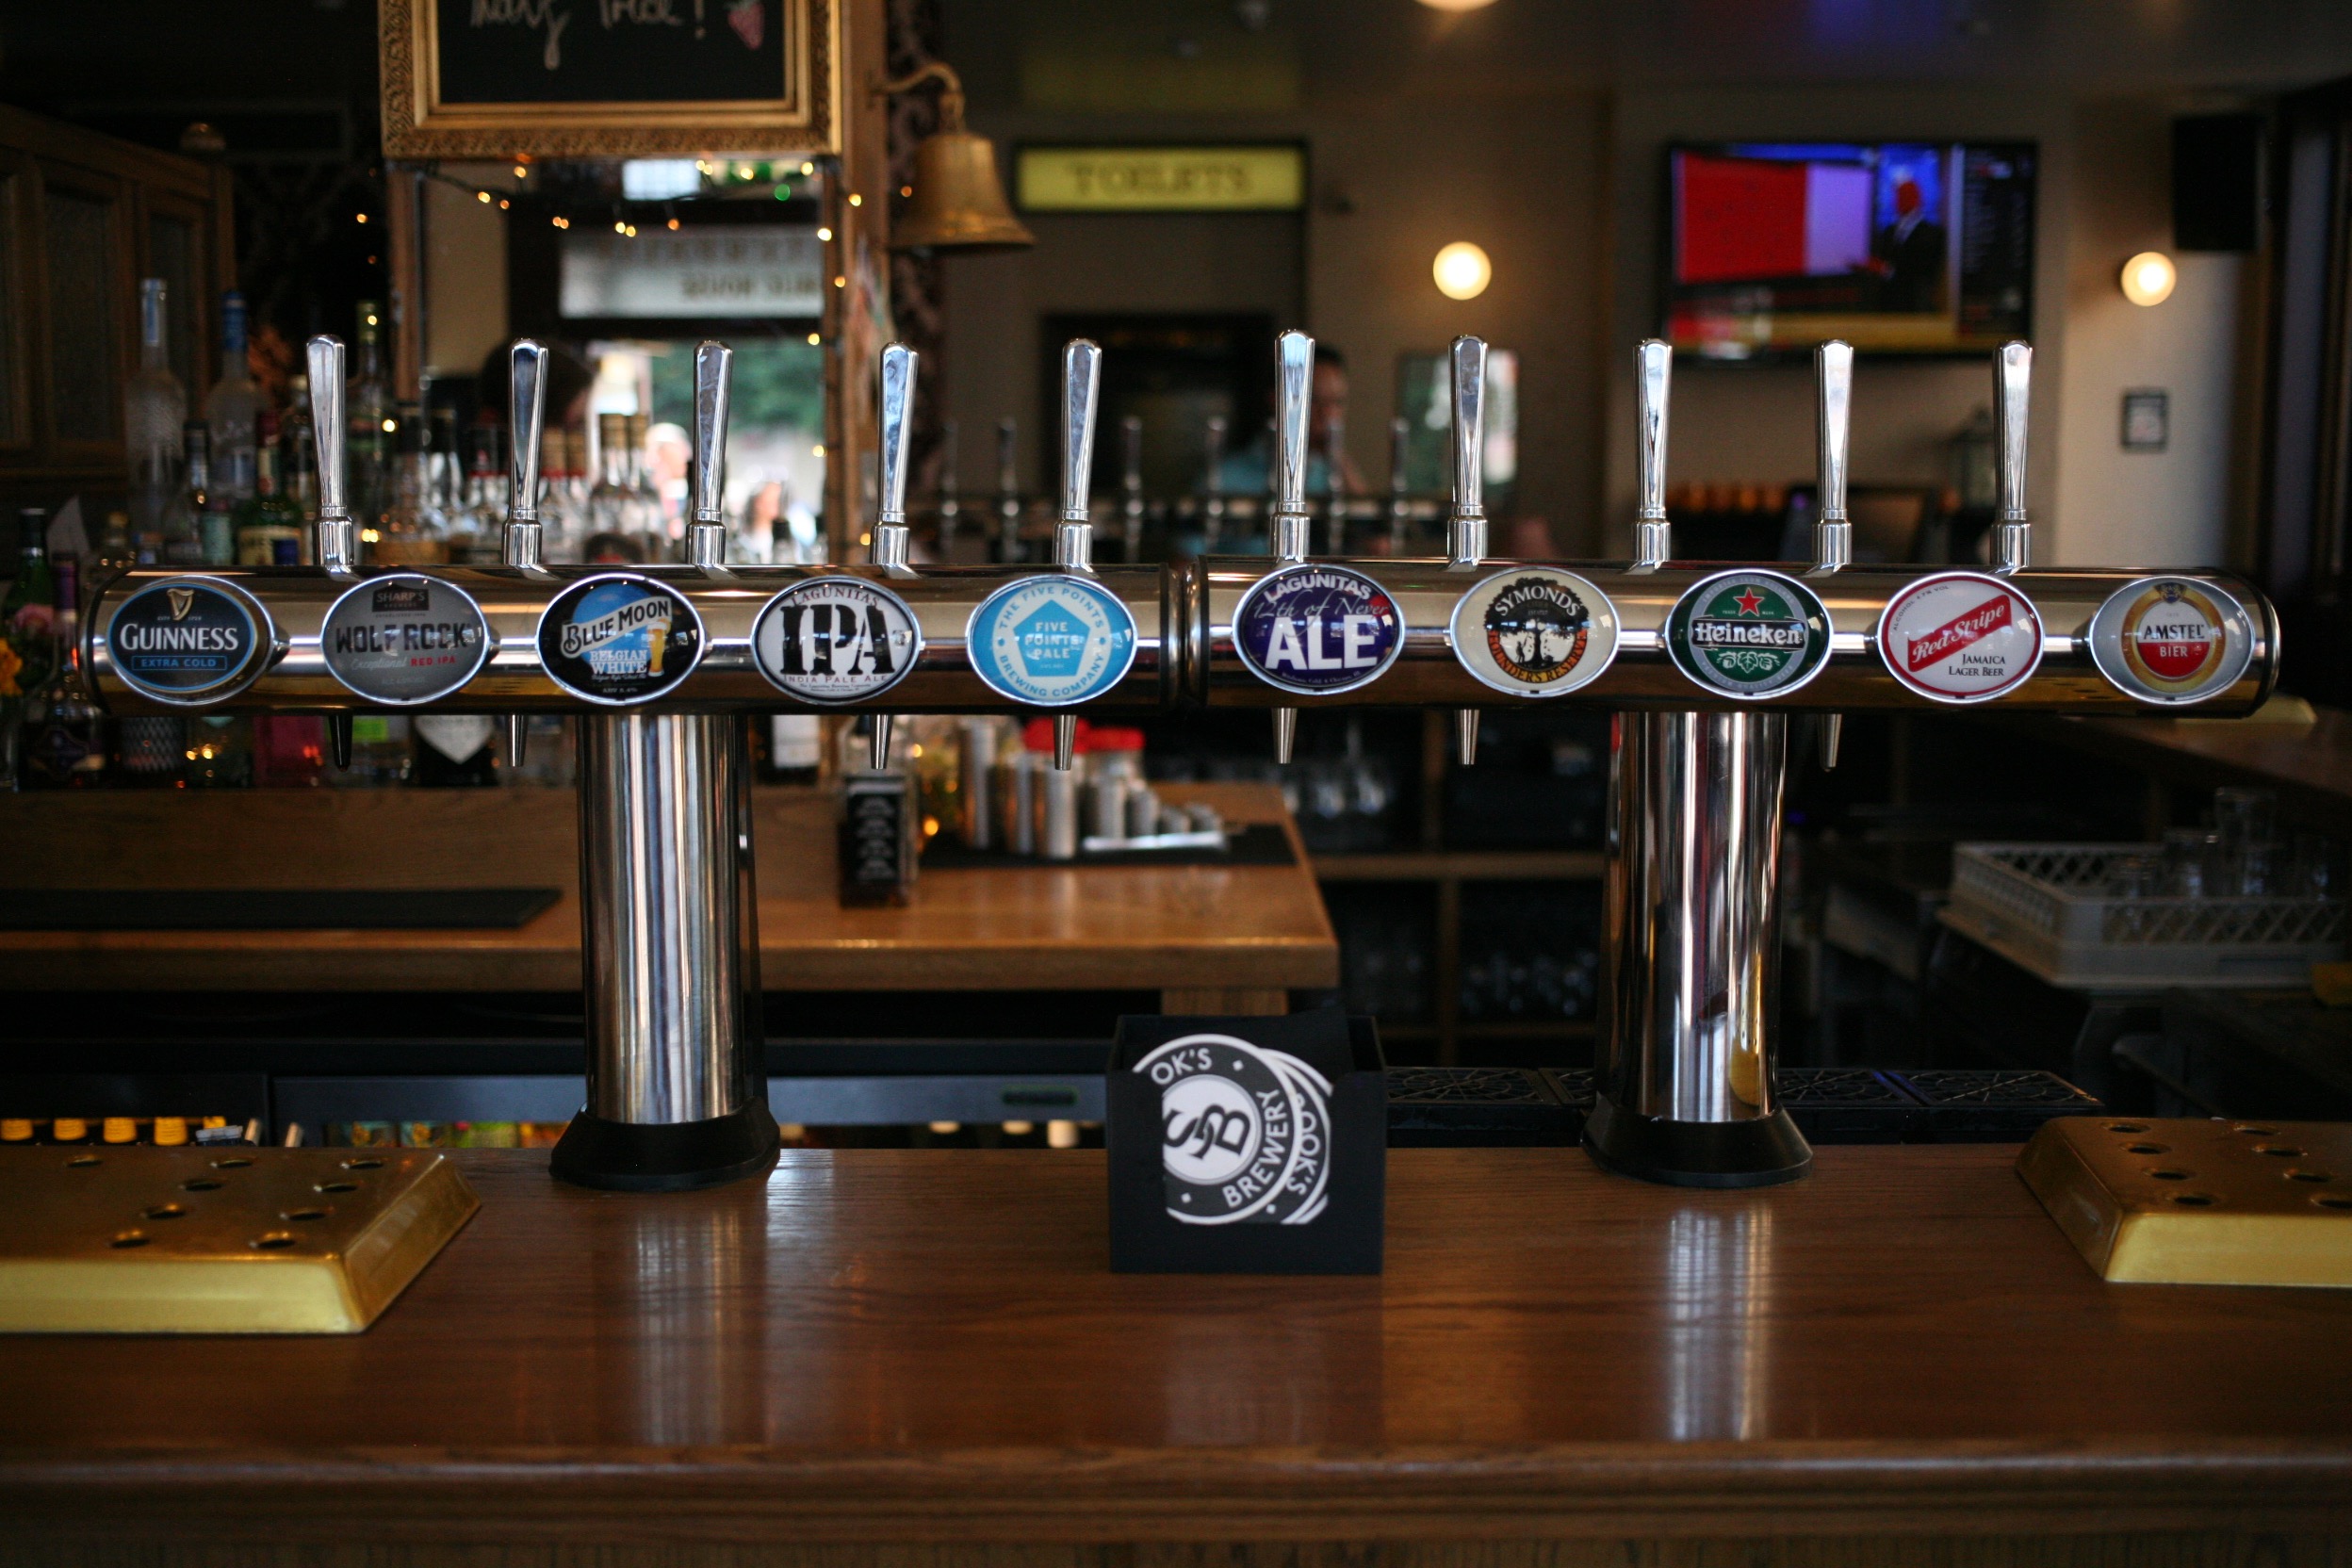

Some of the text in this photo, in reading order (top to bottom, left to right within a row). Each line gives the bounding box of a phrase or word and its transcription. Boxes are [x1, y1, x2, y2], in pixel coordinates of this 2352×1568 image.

[377, 592, 427, 603] SHARP'S
[792, 586, 880, 608] LAGUNITAS
[1264, 574, 1372, 603] LAGUNITAS
[1494, 585, 1580, 616] SYMONDS
[1000, 586, 1104, 629] THE FIVE POINTS
[1254, 592, 1308, 618] 12th
[1334, 596, 1389, 615] Never
[1893, 600, 1915, 630] ALCOHOL
[120, 623, 239, 650] GUINNESS
[336, 622, 468, 653] WOLF ROCK
[564, 600, 669, 654] BLUE MOON
[1036, 622, 1068, 631] FIVE
[1696, 622, 1801, 645] Heineken
[1912, 604, 2005, 663] Red Stripe
[2144, 624, 2204, 640] AMSTEL
[780, 604, 895, 676] IPA
[1025, 633, 1079, 645] POINTS
[1265, 614, 1378, 670] ALE
[2160, 645, 2188, 657] BIER
[140, 659, 217, 667] EXTRA COLD
[410, 658, 433, 666] RED
[437, 656, 456, 664] IPA
[590, 650, 648, 661] BELGIAN
[1034, 648, 1070, 659] PALE
[1488, 629, 1588, 683] FOUNDERS RESERVE
[1962, 653, 2006, 664] JAMAICA
[591, 662, 647, 675] WHITE
[1000, 652, 1104, 696] BREWING COMPANY
[1948, 665, 2004, 677] LAGER BEER
[1222, 1087, 1290, 1208] BREWERY
